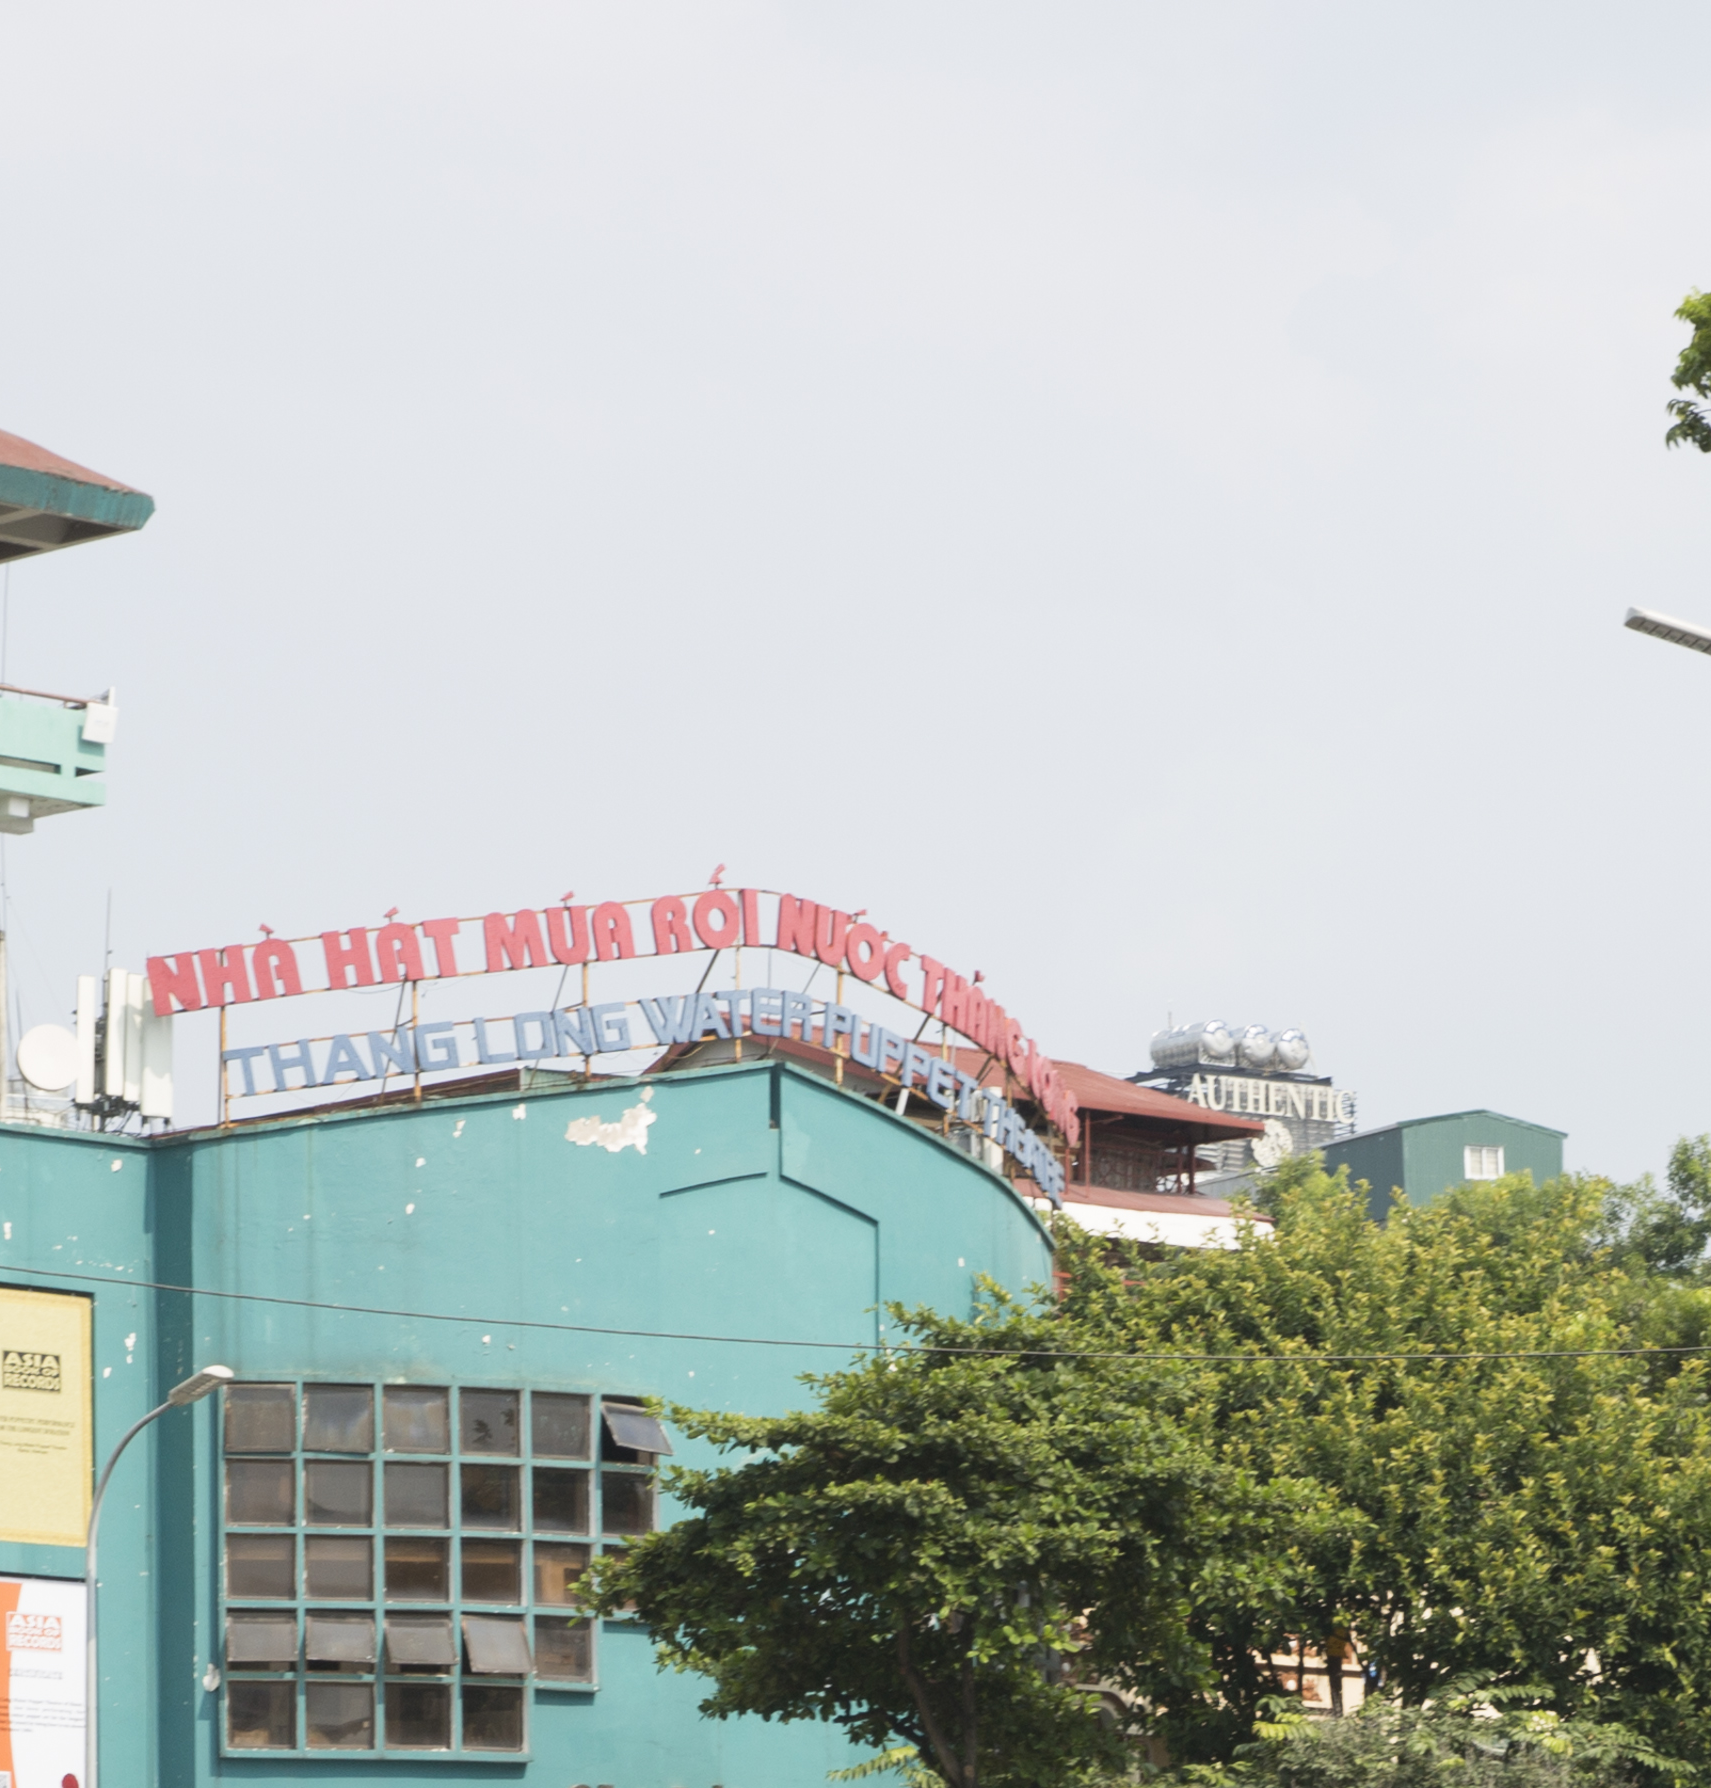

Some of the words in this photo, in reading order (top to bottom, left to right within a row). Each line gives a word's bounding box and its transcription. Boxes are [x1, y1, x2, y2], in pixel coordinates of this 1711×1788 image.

[147, 924, 303, 1017] NHÀ
[321, 907, 460, 990] HÁT
[483, 891, 636, 972] MÚA
[651, 863, 772, 955] RỐI
[775, 893, 911, 1000] NƯỚC
[223, 1021, 460, 1096] THANG
[474, 1002, 631, 1065] LONG
[639, 987, 813, 1044] WATER
[823, 1002, 979, 1120] PUPPET
[1187, 1073, 1356, 1124] AUTHENTIC
[4, 1352, 59, 1369] ASIA
[4, 1373, 60, 1390] RECORDS
[9, 1613, 60, 1630] ASIA
[9, 1634, 61, 1650] RECORDS
